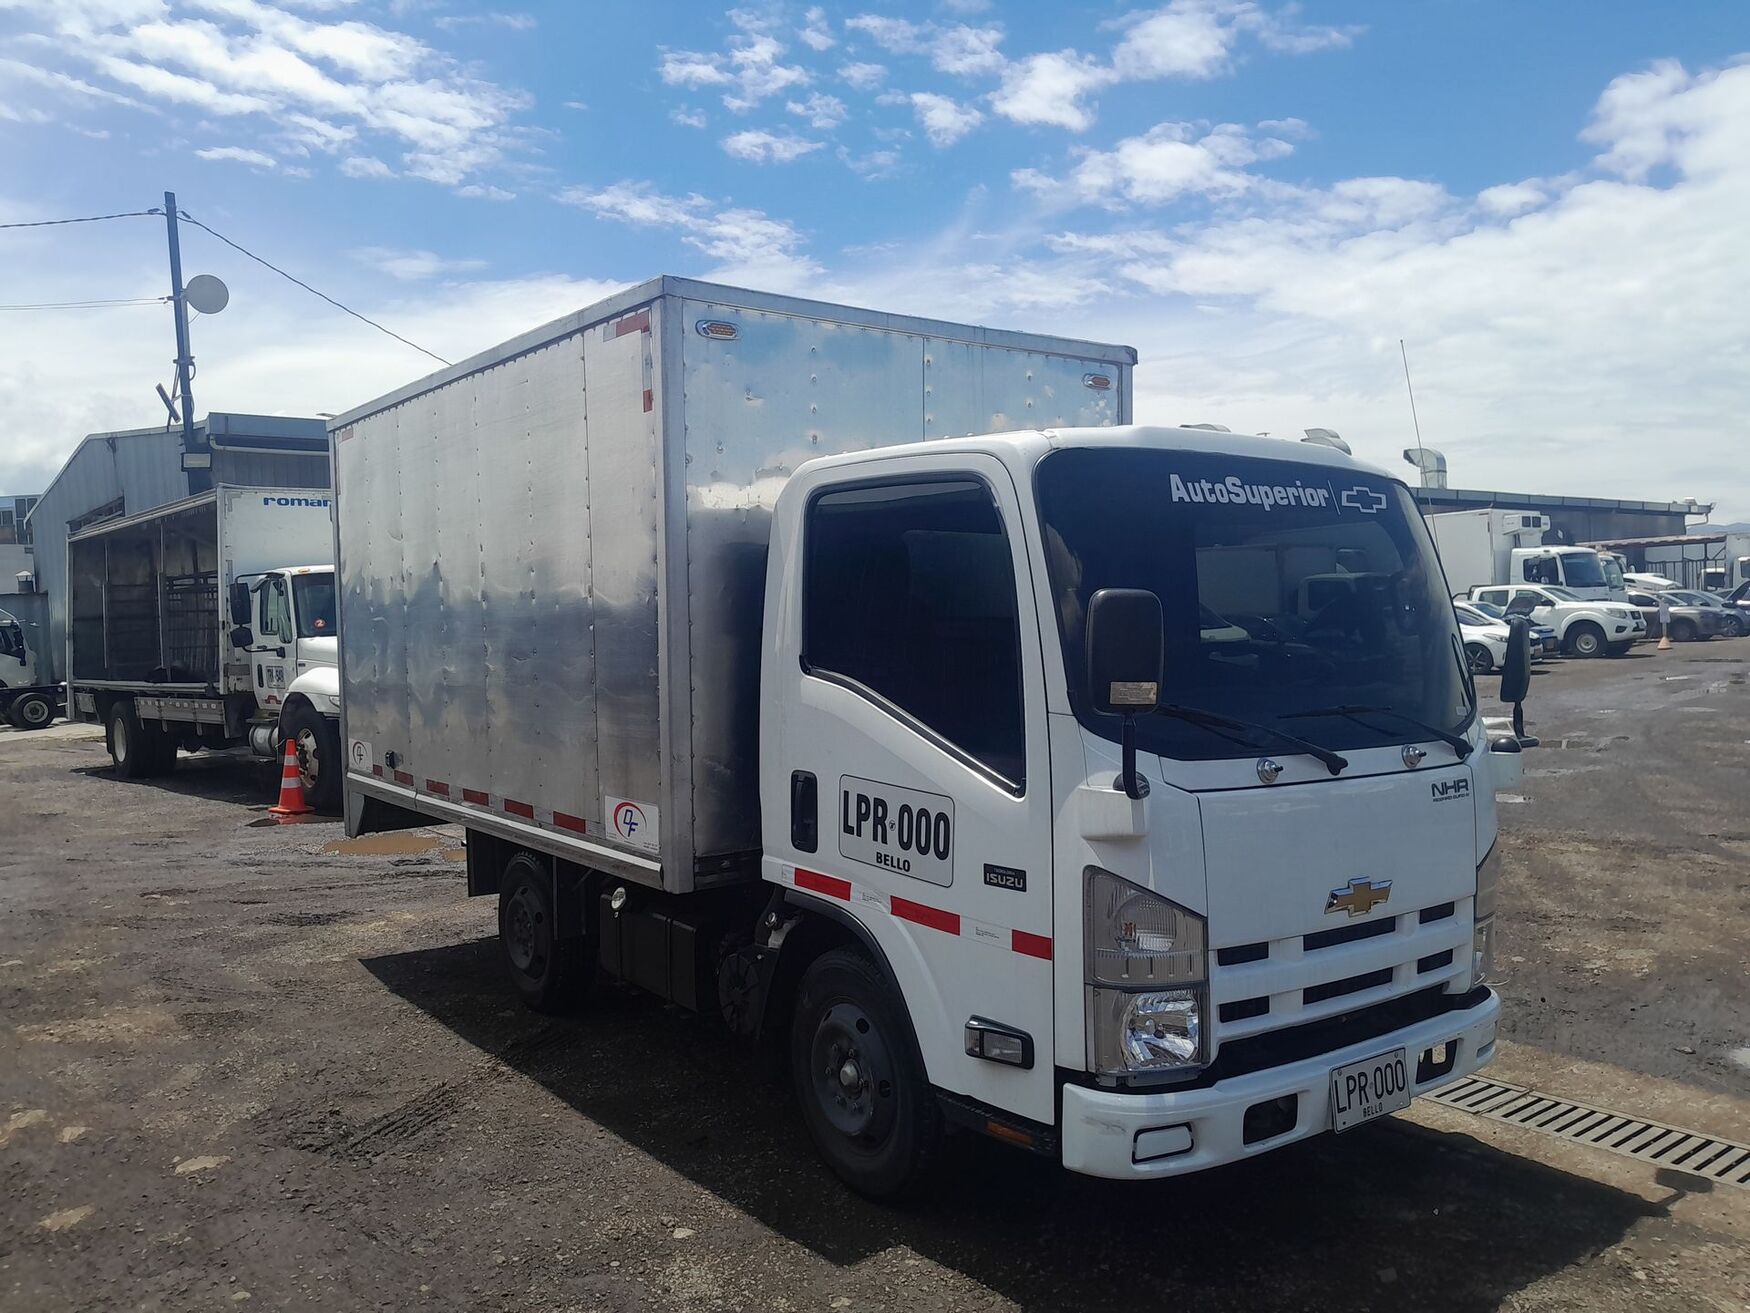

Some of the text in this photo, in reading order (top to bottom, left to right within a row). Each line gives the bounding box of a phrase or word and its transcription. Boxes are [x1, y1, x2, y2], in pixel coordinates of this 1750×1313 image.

[1169, 473, 1330, 511] AutoSuperior
[1431, 778, 1469, 797] NHR
[843, 790, 888, 845] LPR
[876, 851, 911, 873] BELLO
[986, 872, 1023, 888] ISUZU
[1362, 1102, 1384, 1118] BELLO
